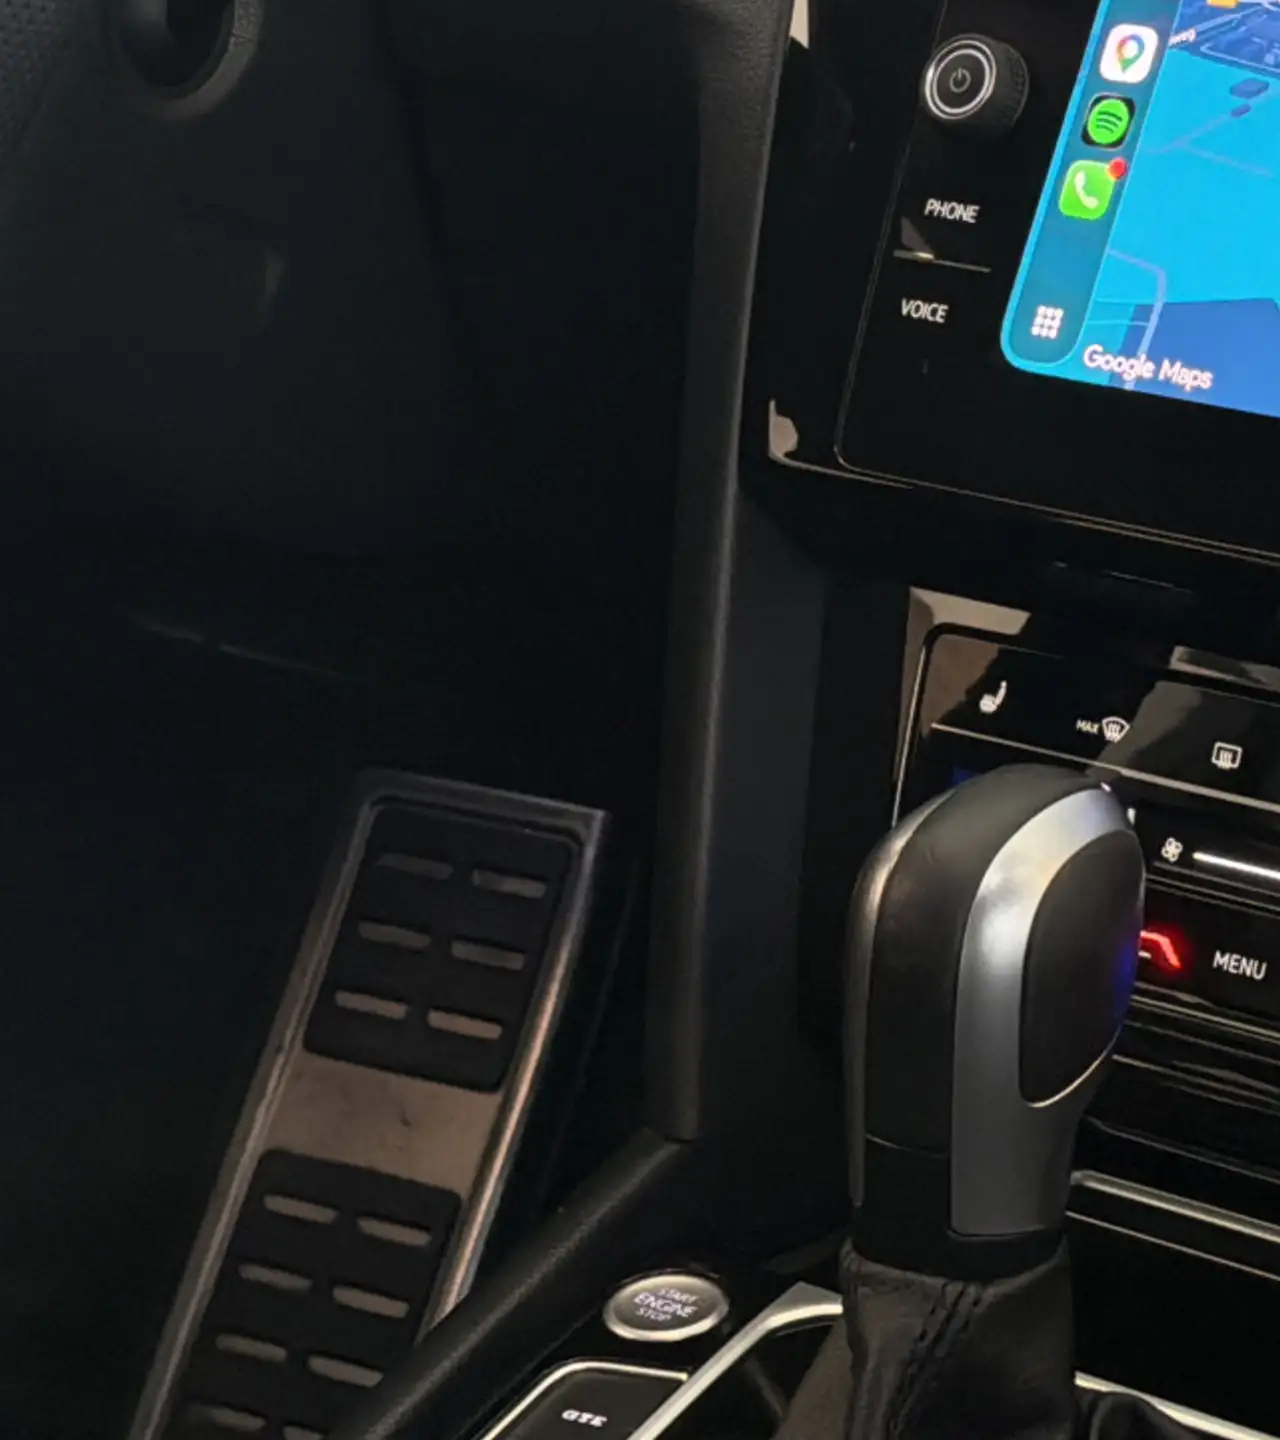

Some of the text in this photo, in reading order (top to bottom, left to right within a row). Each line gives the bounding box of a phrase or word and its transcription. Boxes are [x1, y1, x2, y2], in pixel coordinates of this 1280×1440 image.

[924, 198, 980, 224] PHONE
[900, 297, 949, 323] VOICE
[1082, 343, 1214, 392] Google Maps
[1212, 950, 1268, 982] MENU
[633, 1292, 698, 1319] ENGINE
[659, 1287, 699, 1304] START
[635, 1308, 672, 1322] STOP
